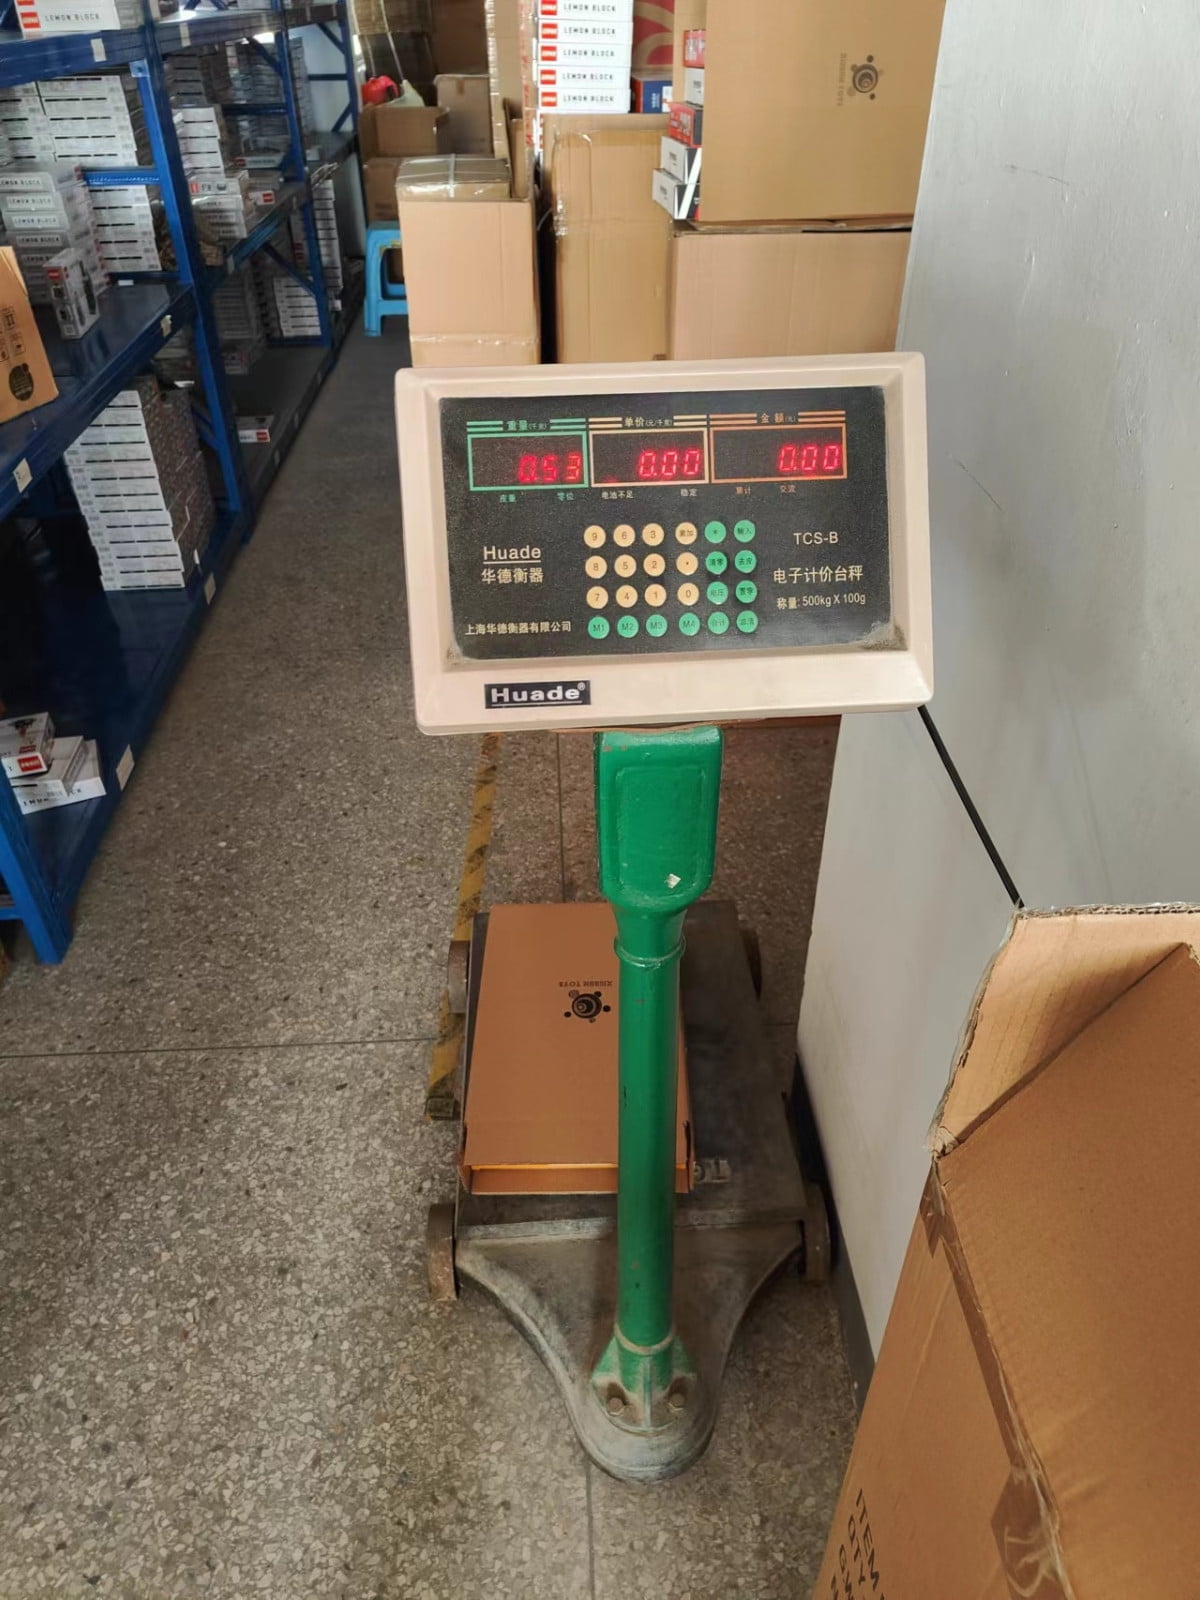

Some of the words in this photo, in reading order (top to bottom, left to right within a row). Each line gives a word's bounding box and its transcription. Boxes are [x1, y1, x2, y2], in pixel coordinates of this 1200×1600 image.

[592, 4, 616, 12] BLOCK
[592, 27, 616, 35] BLOCK
[638, 448, 702, 478] 0.00
[779, 444, 841, 473] 0.00
[793, 532, 839, 545] TCS-B
[483, 545, 541, 560] Huade
[481, 567, 543, 584] 华德衡器
[773, 565, 863, 584] 电子计价台秤
[802, 595, 832, 607] 500kg
[843, 593, 866, 605] 100g
[465, 621, 571, 635] 上海华德衡器有限公司
[856, 1488, 879, 1591] ITEM
